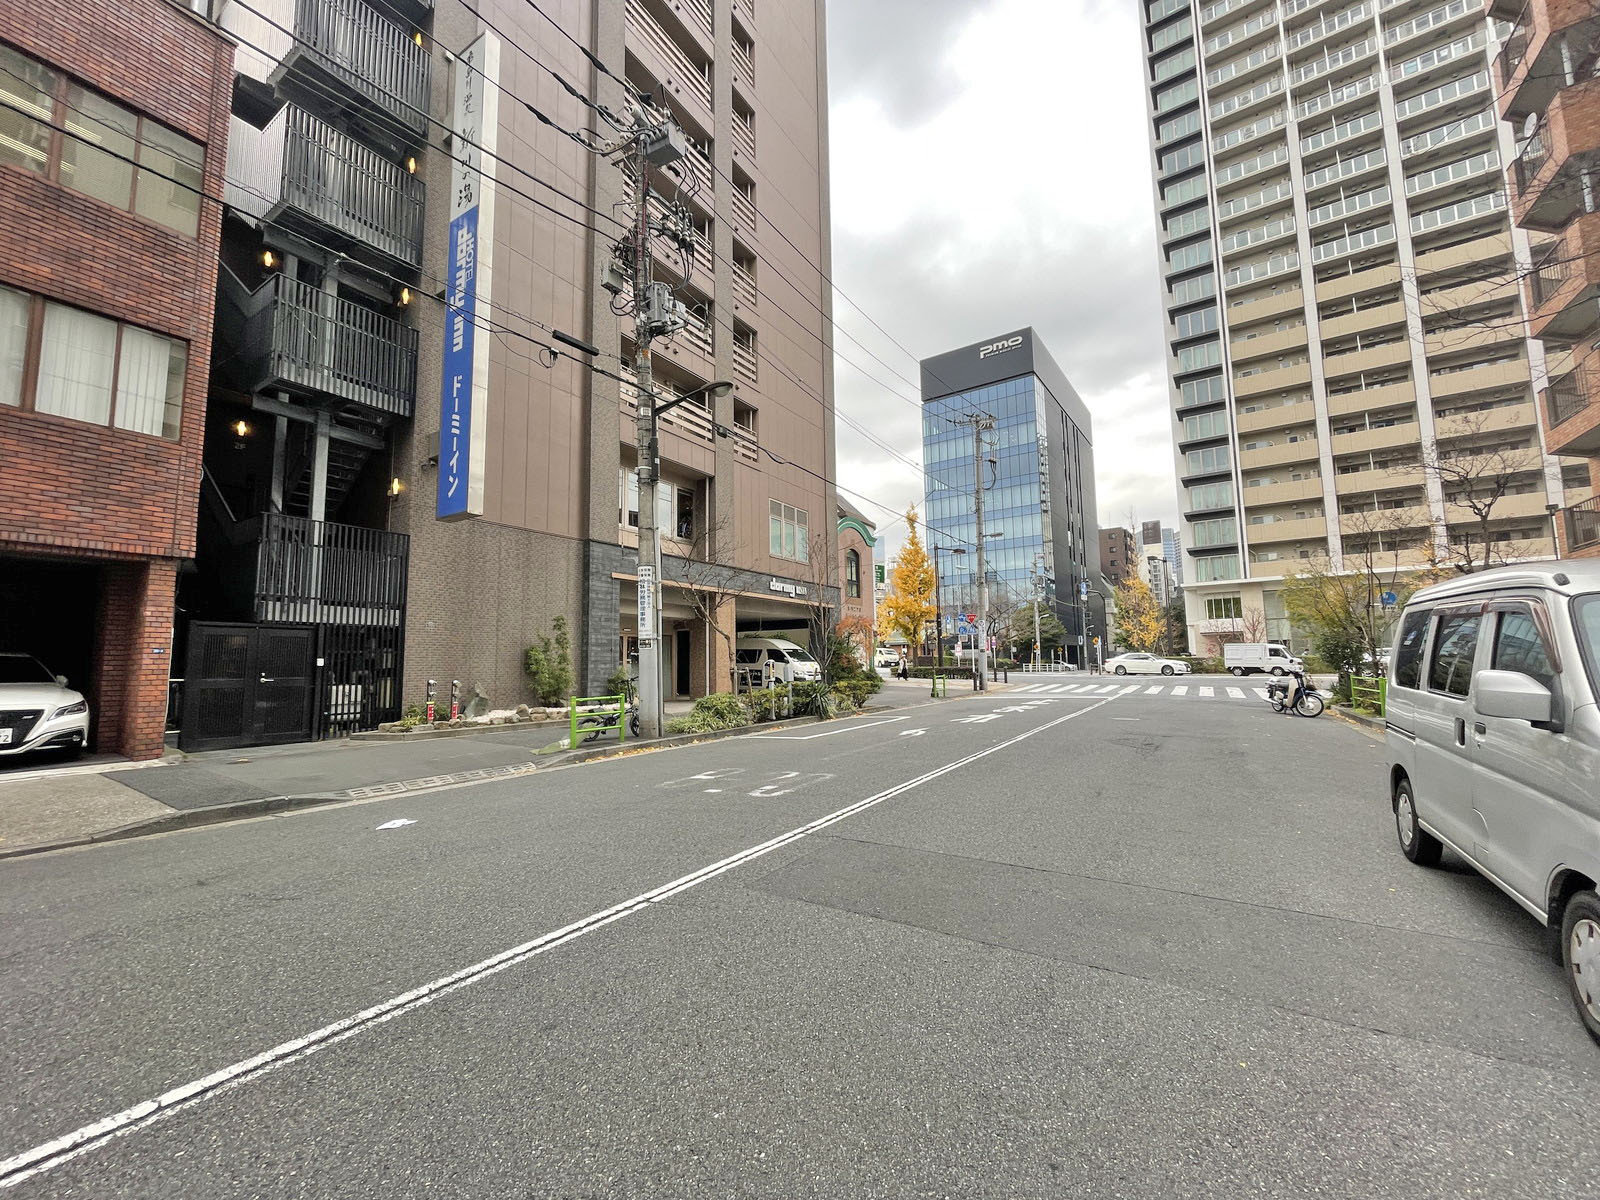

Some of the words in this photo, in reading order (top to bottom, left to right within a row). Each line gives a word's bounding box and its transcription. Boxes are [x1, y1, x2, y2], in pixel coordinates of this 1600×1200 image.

[465, 235, 475, 282] HOTEL
[447, 375, 463, 498] ドーミーイン
[770, 577, 795, 597] dormy
